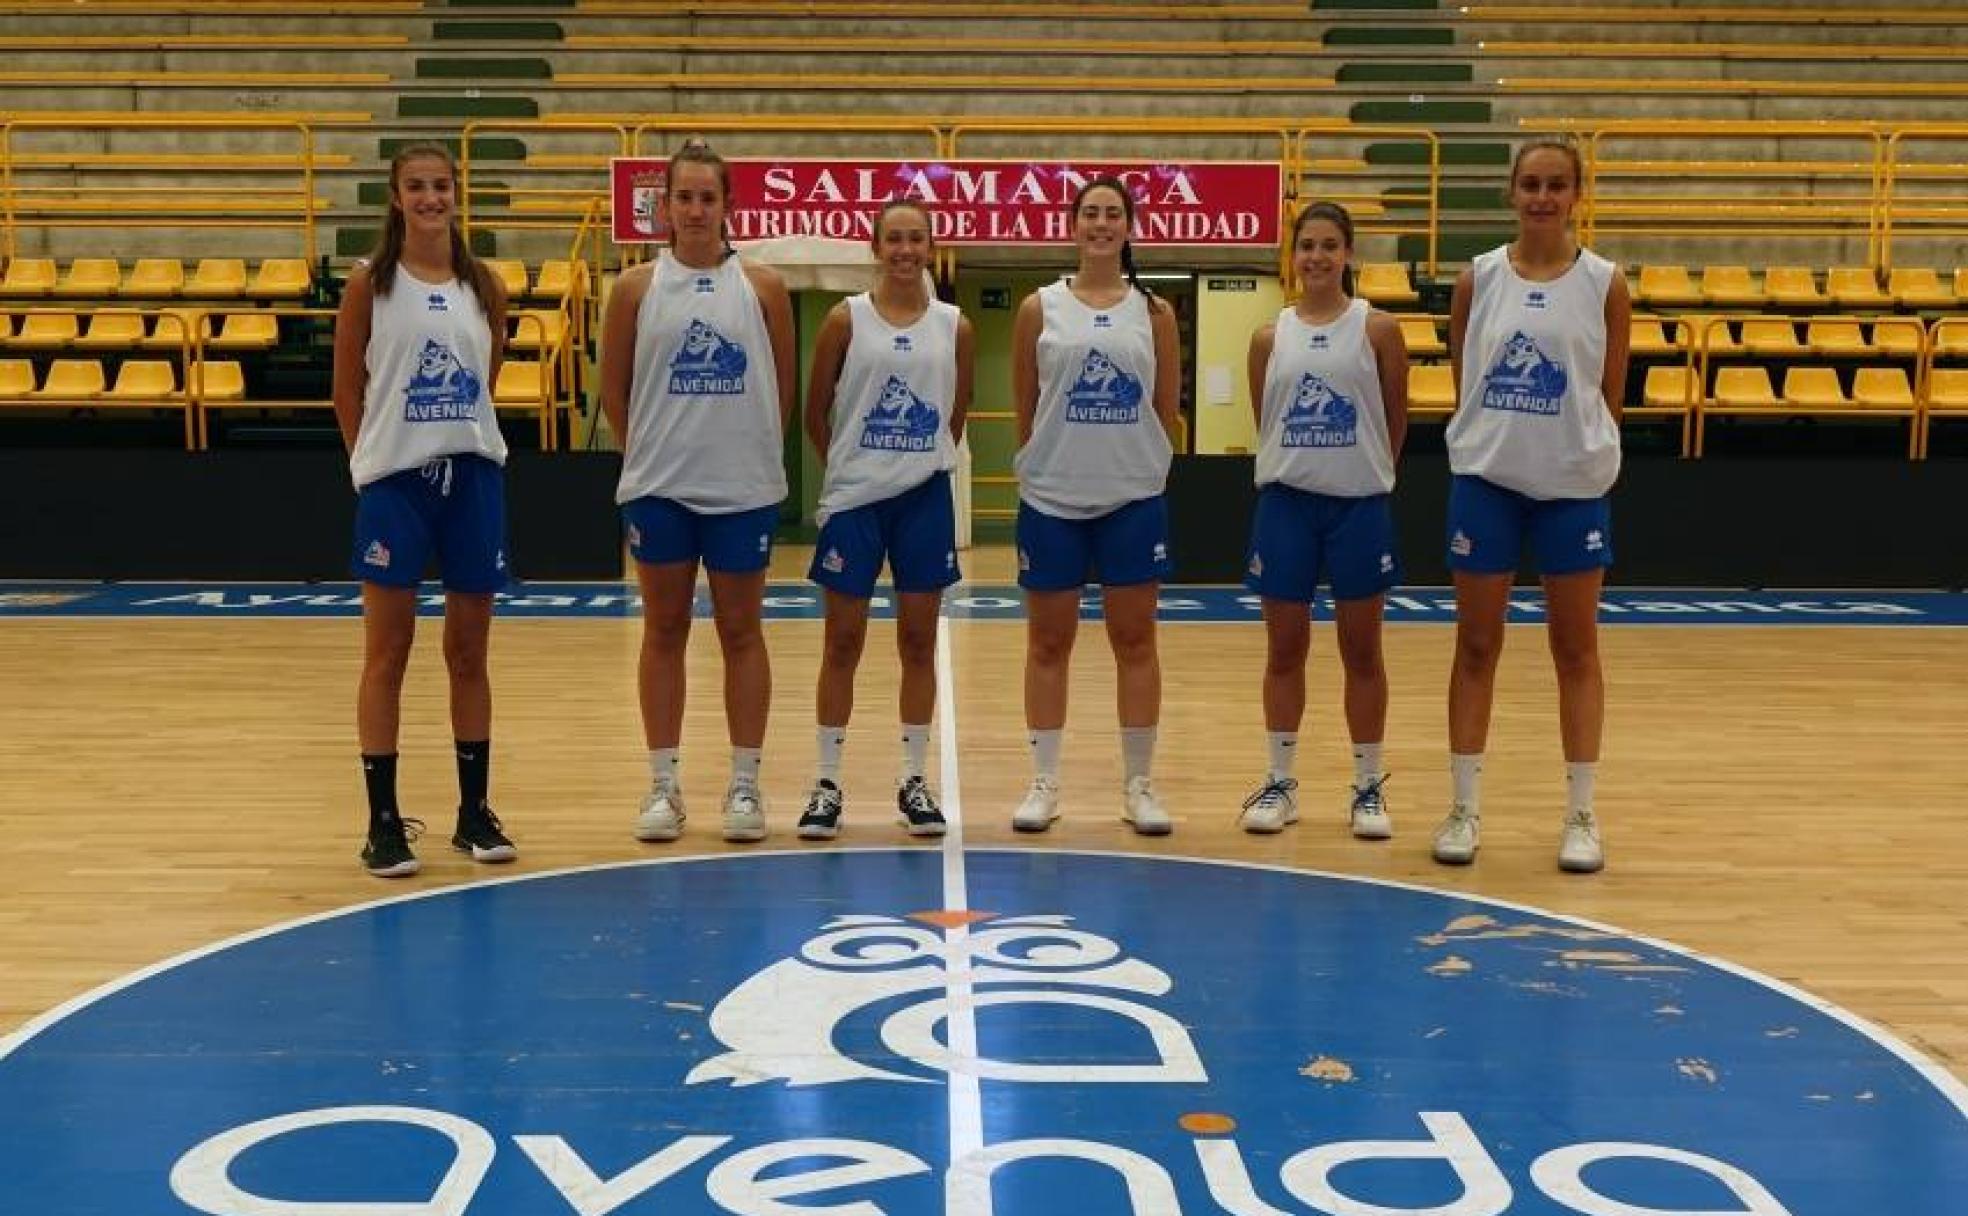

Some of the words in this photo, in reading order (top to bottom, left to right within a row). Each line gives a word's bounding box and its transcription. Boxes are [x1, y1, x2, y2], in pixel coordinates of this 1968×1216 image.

[725, 209, 874, 238] TRIMON
[928, 210, 977, 237] DE
[988, 210, 1032, 238] LA
[1043, 210, 1261, 239] HANIDAD
[169, 1104, 1793, 1216] avenida
